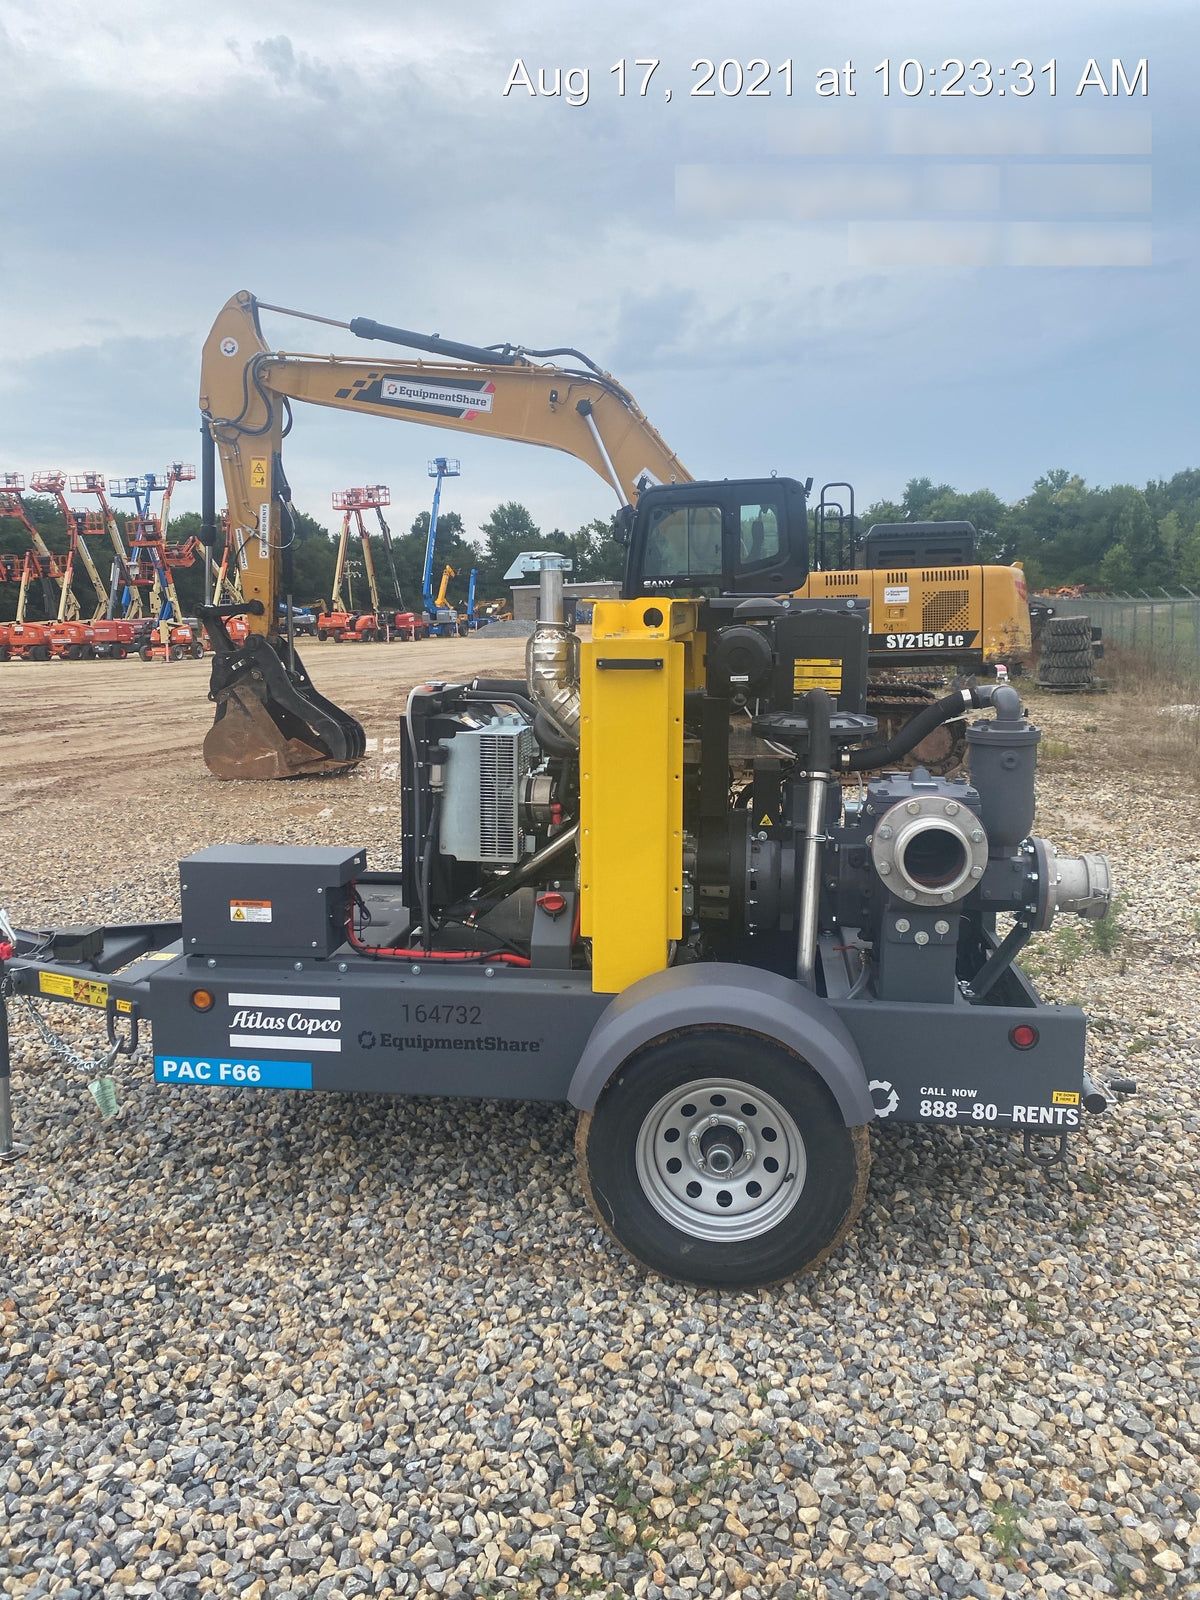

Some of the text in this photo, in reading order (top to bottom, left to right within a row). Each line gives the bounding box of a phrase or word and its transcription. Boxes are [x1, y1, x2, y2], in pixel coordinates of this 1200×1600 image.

[399, 385, 488, 407] EquipmentShare
[643, 580, 674, 589] SANY
[886, 633, 964, 649] SY215C LC
[228, 1010, 342, 1035] Atlas Copco
[402, 1004, 482, 1025] 164732
[380, 1033, 541, 1053] EquipmentShare
[162, 1060, 262, 1082] PAC F66
[920, 1086, 978, 1098] CALL NOW
